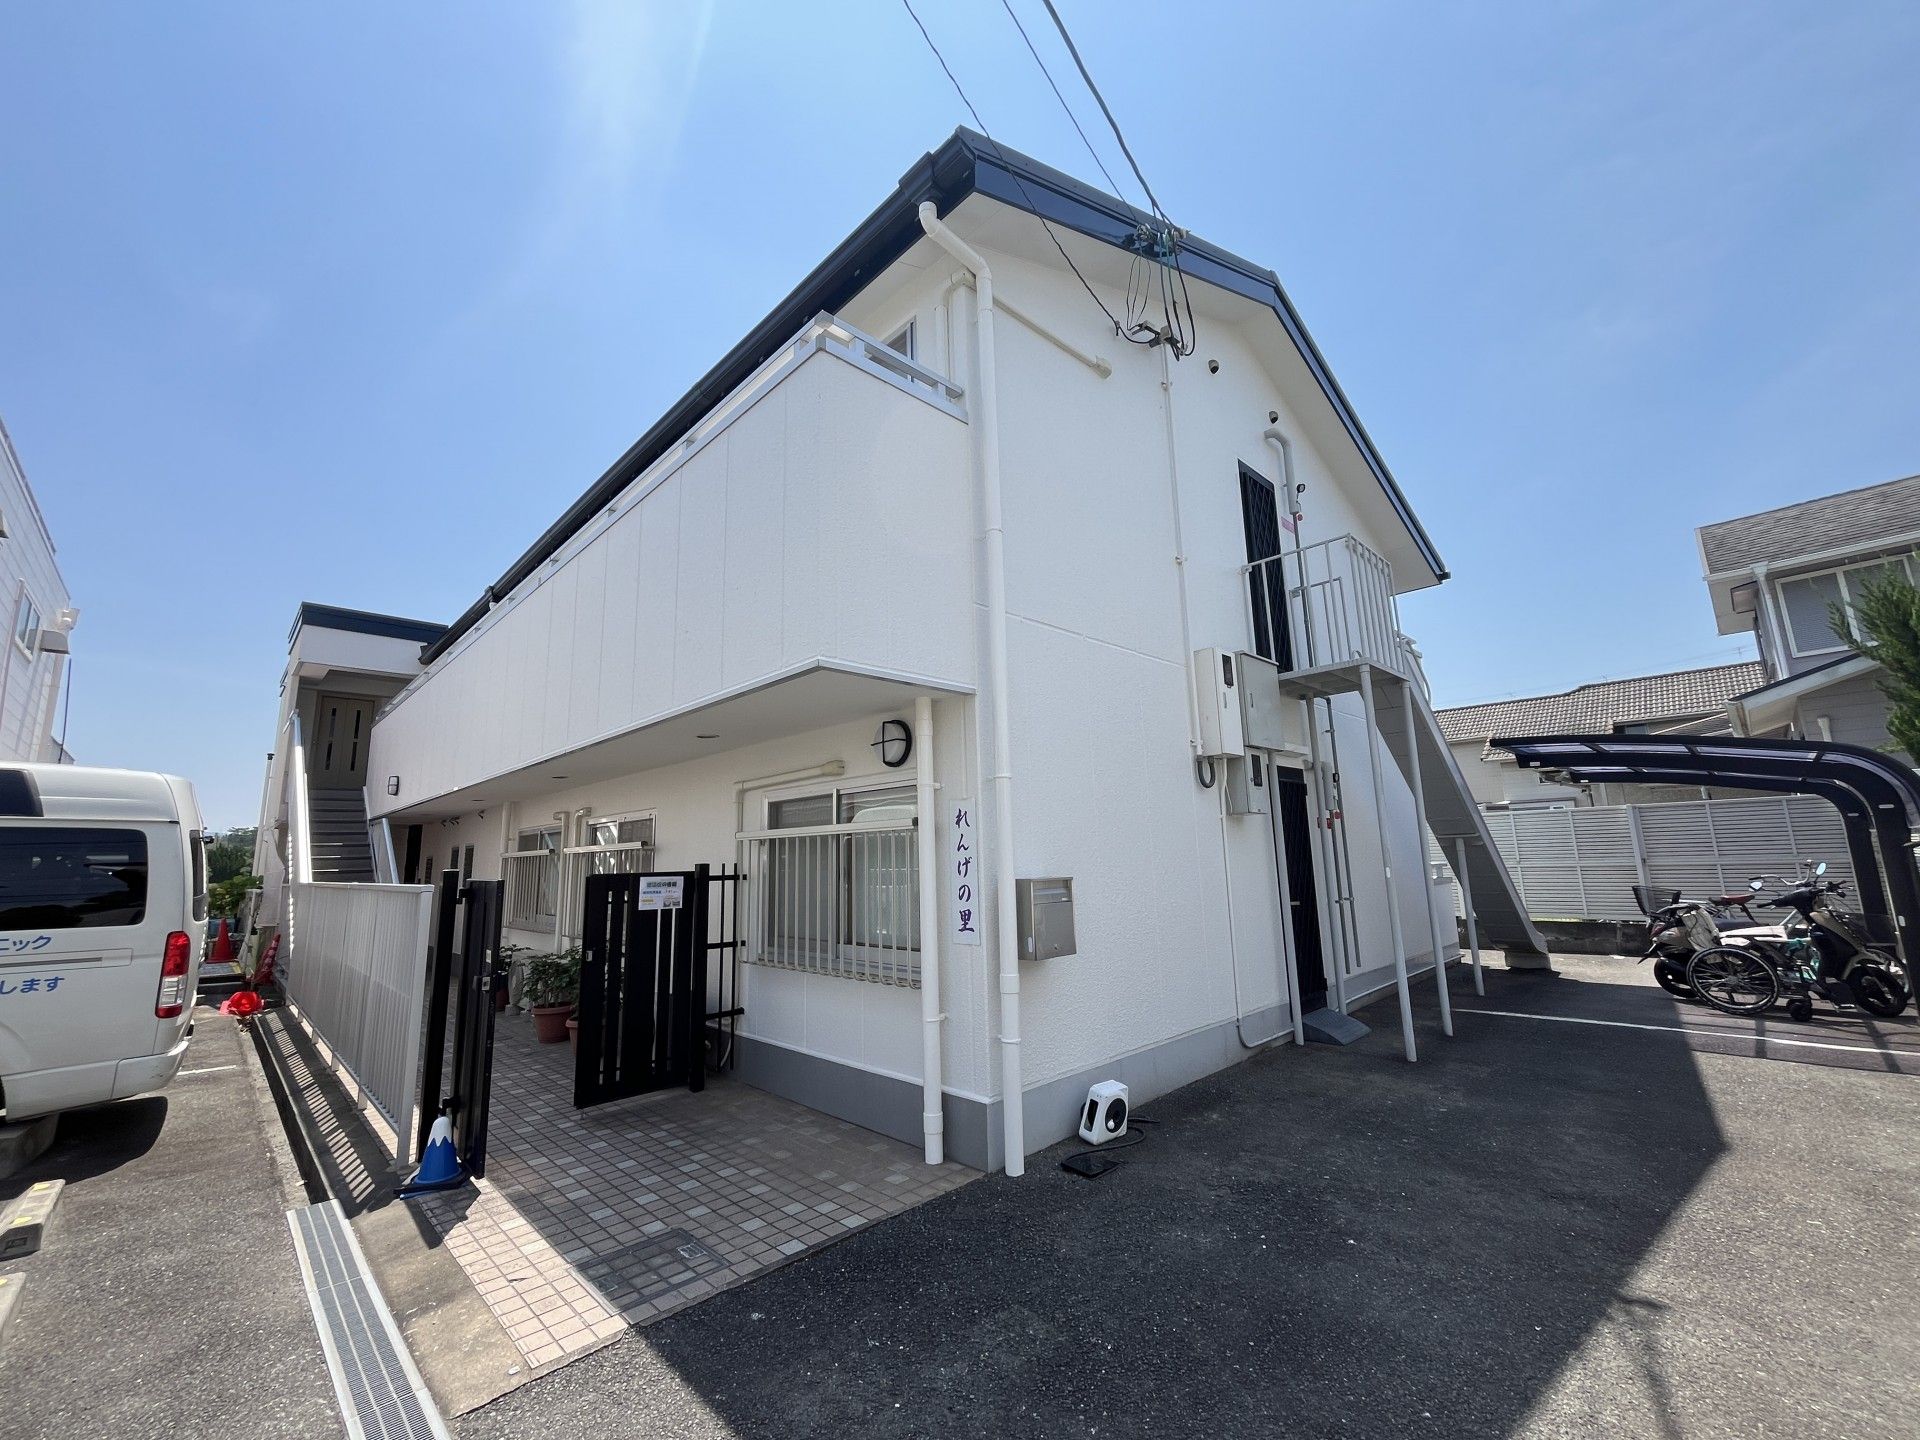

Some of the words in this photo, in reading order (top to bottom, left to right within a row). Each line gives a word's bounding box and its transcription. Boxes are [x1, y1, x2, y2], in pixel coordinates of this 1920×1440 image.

[955, 808, 975, 933] れんげの里
[0, 976, 65, 995] します
